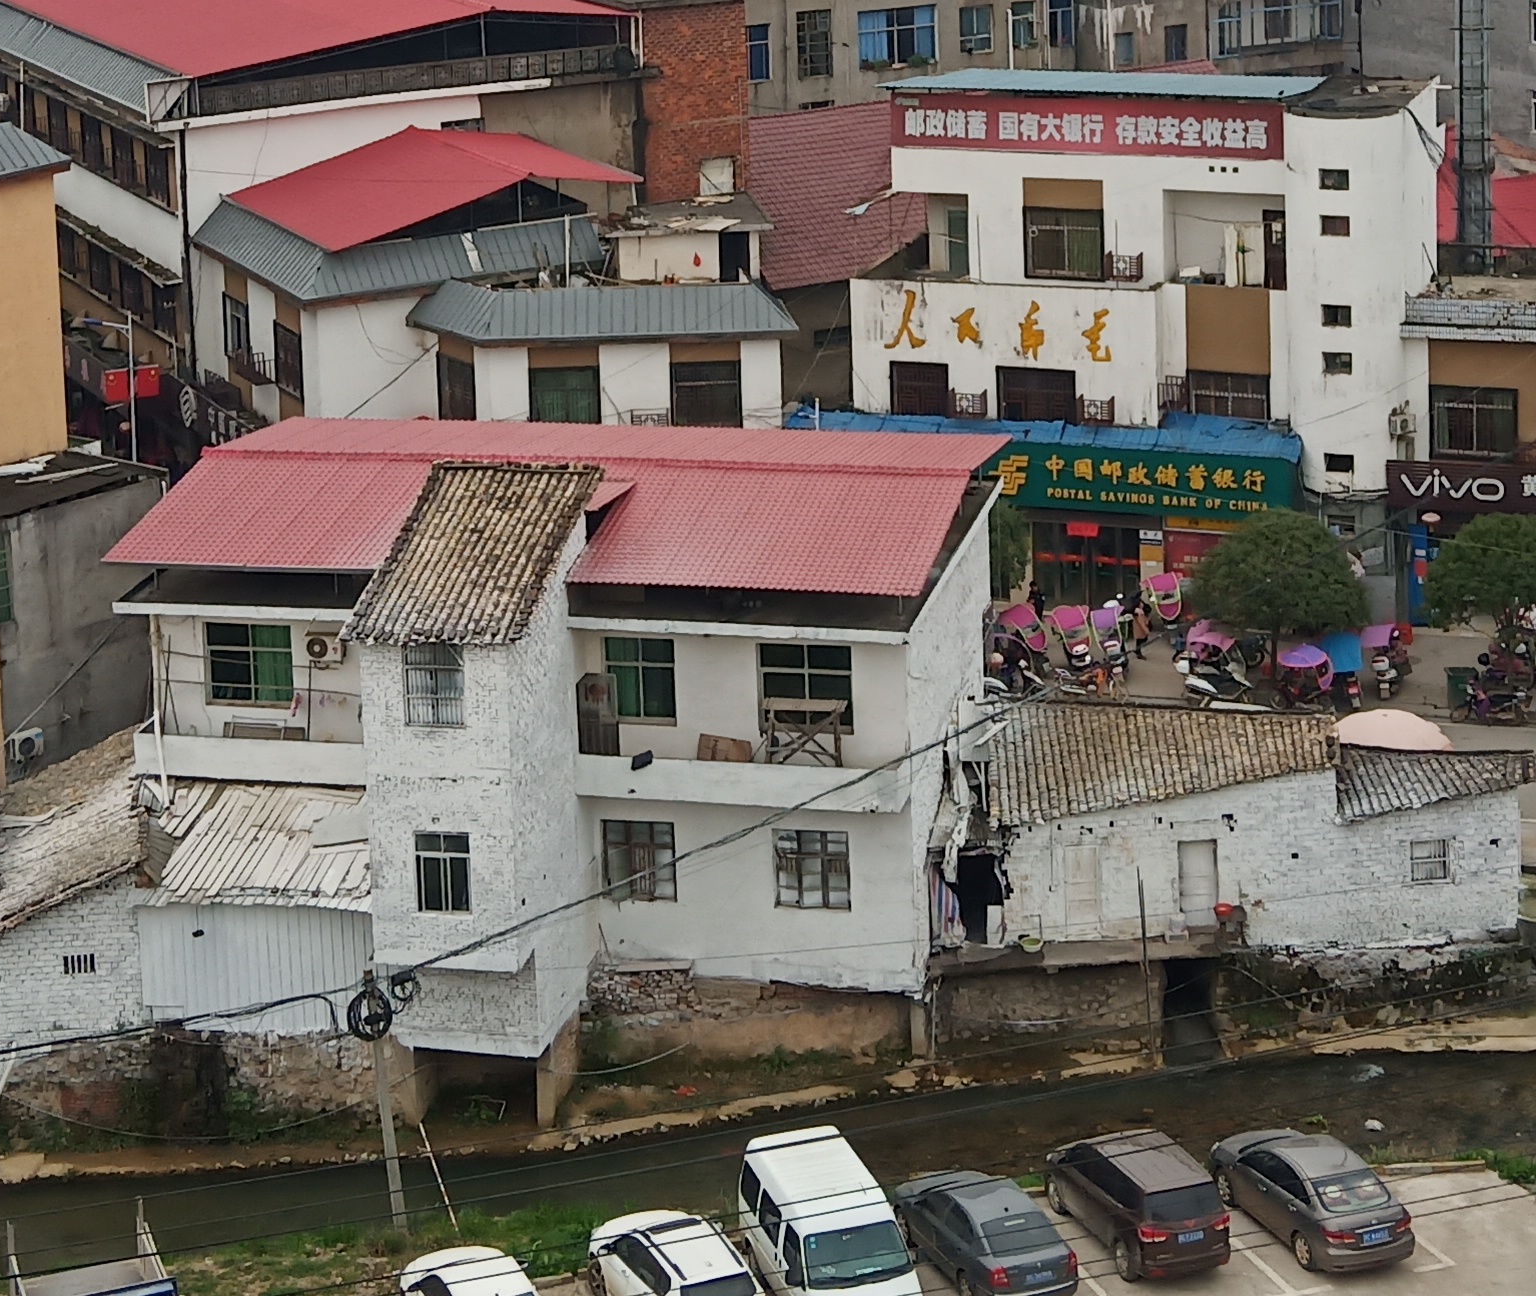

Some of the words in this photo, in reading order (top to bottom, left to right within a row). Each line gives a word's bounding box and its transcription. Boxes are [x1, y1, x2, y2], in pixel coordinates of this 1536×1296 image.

[904, 108, 987, 140] 邮政储蓄
[998, 111, 1105, 145] 国有大银行
[1115, 114, 1268, 150] 存款安全收益高
[1045, 454, 1266, 493] 中国邮政储蓄银行
[1046, 487, 1093, 501] POSTAL
[1100, 490, 1155, 505] SAVINGS
[1162, 495, 1197, 508] BANK
[1205, 498, 1222, 509] OF
[1229, 500, 1268, 512] CHINA
